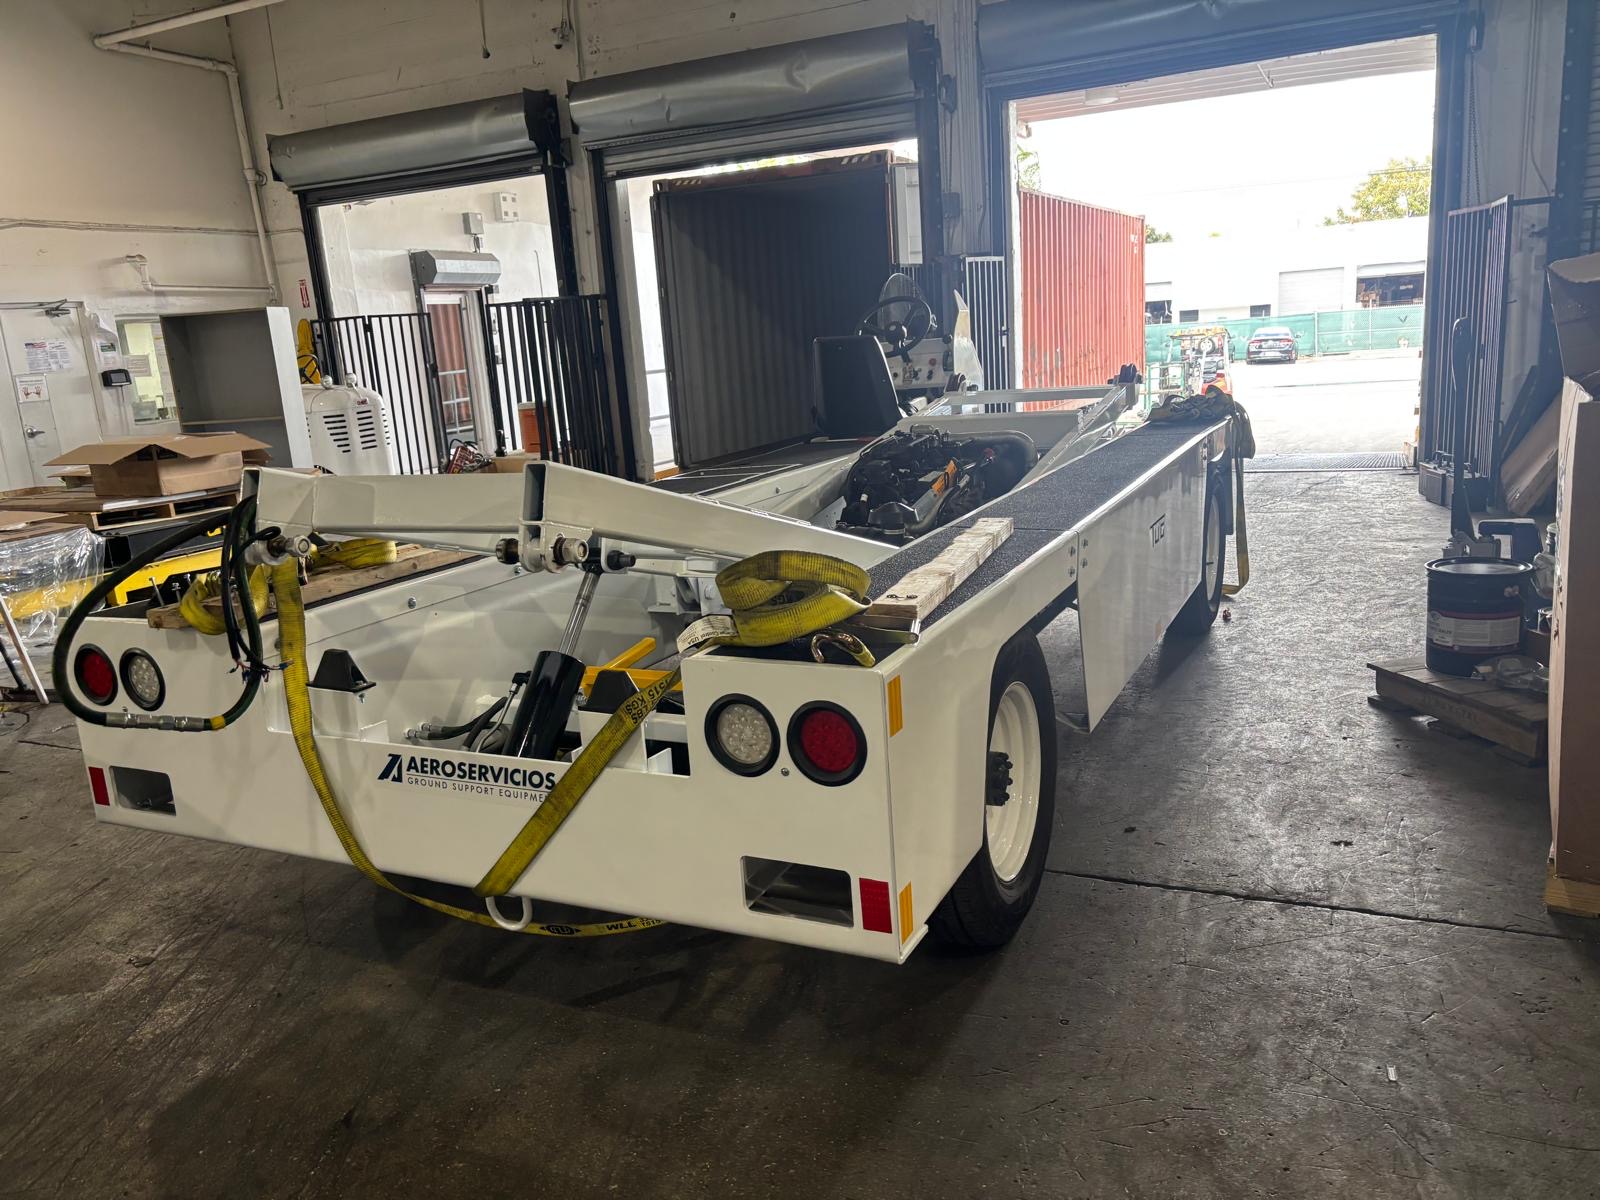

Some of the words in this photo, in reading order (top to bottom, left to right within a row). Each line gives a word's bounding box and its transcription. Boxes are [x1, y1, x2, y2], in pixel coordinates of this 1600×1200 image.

[1150, 513, 1166, 548] TUG
[688, 636, 700, 645] USA
[625, 695, 647, 715] KGS
[631, 703, 650, 724] LBS
[406, 756, 556, 790] AEROSERVICIOS
[407, 776, 448, 789] GROUND
[452, 783, 494, 795] SUPPORT
[606, 921, 637, 931] WLL
